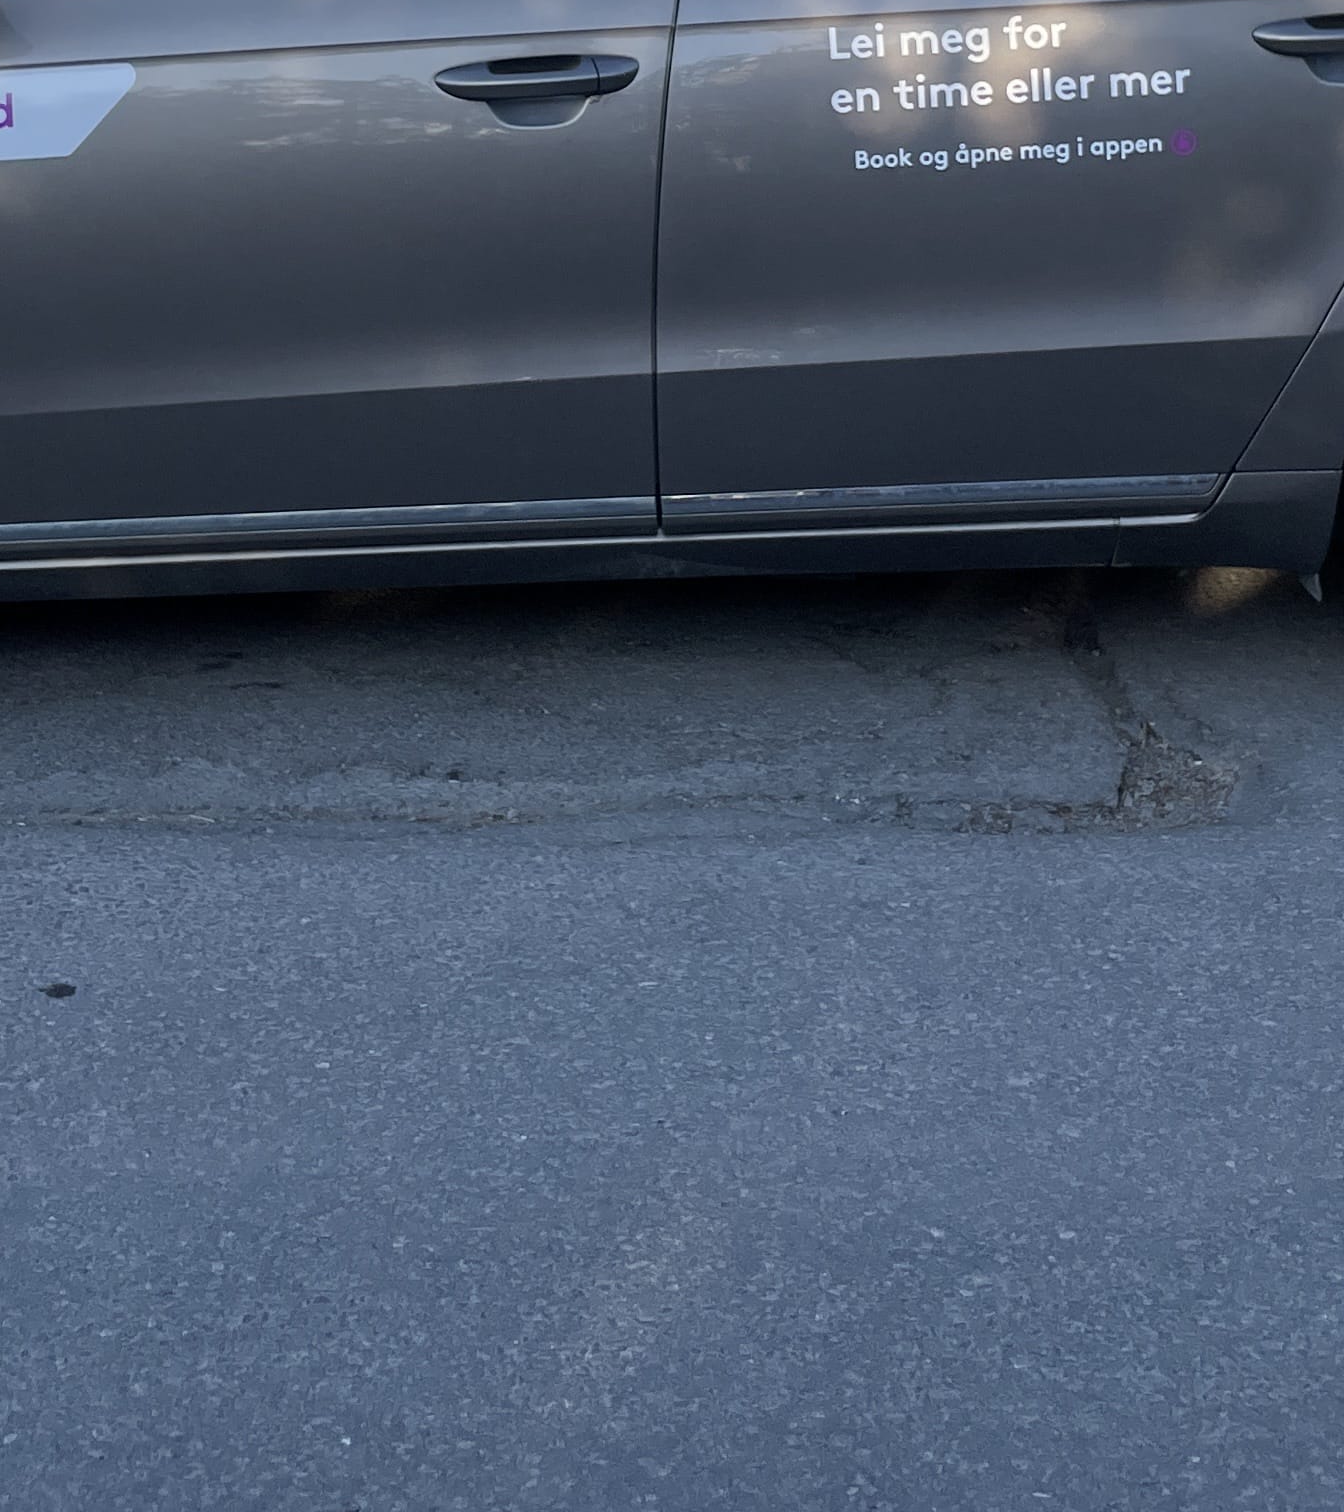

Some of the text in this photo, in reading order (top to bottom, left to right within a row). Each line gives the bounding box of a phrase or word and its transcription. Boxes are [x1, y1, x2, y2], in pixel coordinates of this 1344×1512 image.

[828, 15, 1067, 63] Lei meg for
[830, 67, 1191, 114] en time eller mer
[855, 135, 1163, 171] Book og åpne meg i appen
